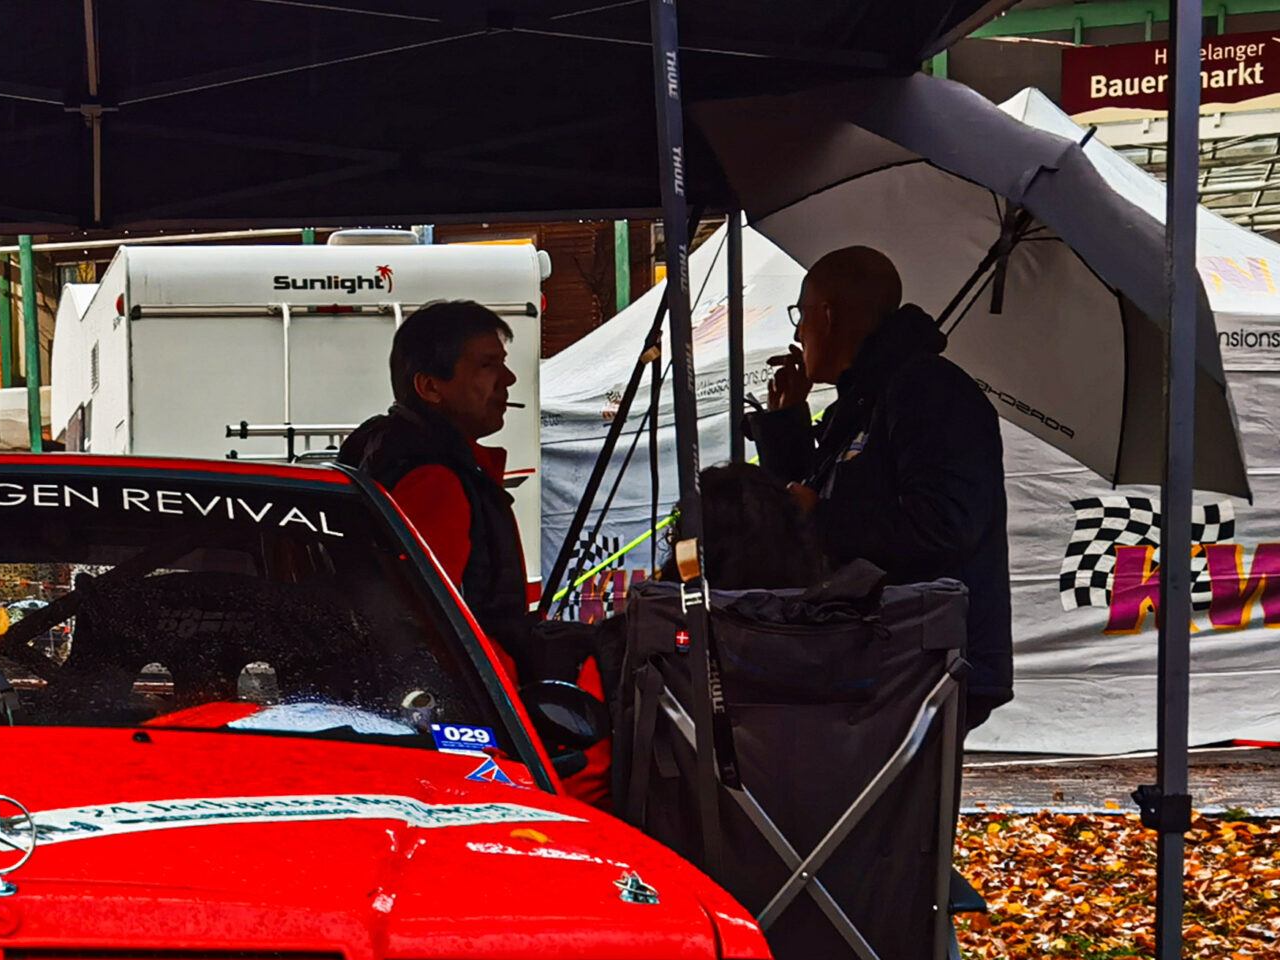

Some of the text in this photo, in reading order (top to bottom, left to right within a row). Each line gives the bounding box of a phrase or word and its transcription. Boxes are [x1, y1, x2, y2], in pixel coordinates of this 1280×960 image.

[1155, 43, 1265, 65] Helanger
[666, 51, 680, 99] THULE
[1090, 62, 1264, 98] Bauerarkt
[672, 147, 685, 197] THULE
[273, 275, 385, 294] Sunlight
[123, 490, 344, 538] REVIVAL
[444, 726, 490, 743] 029
